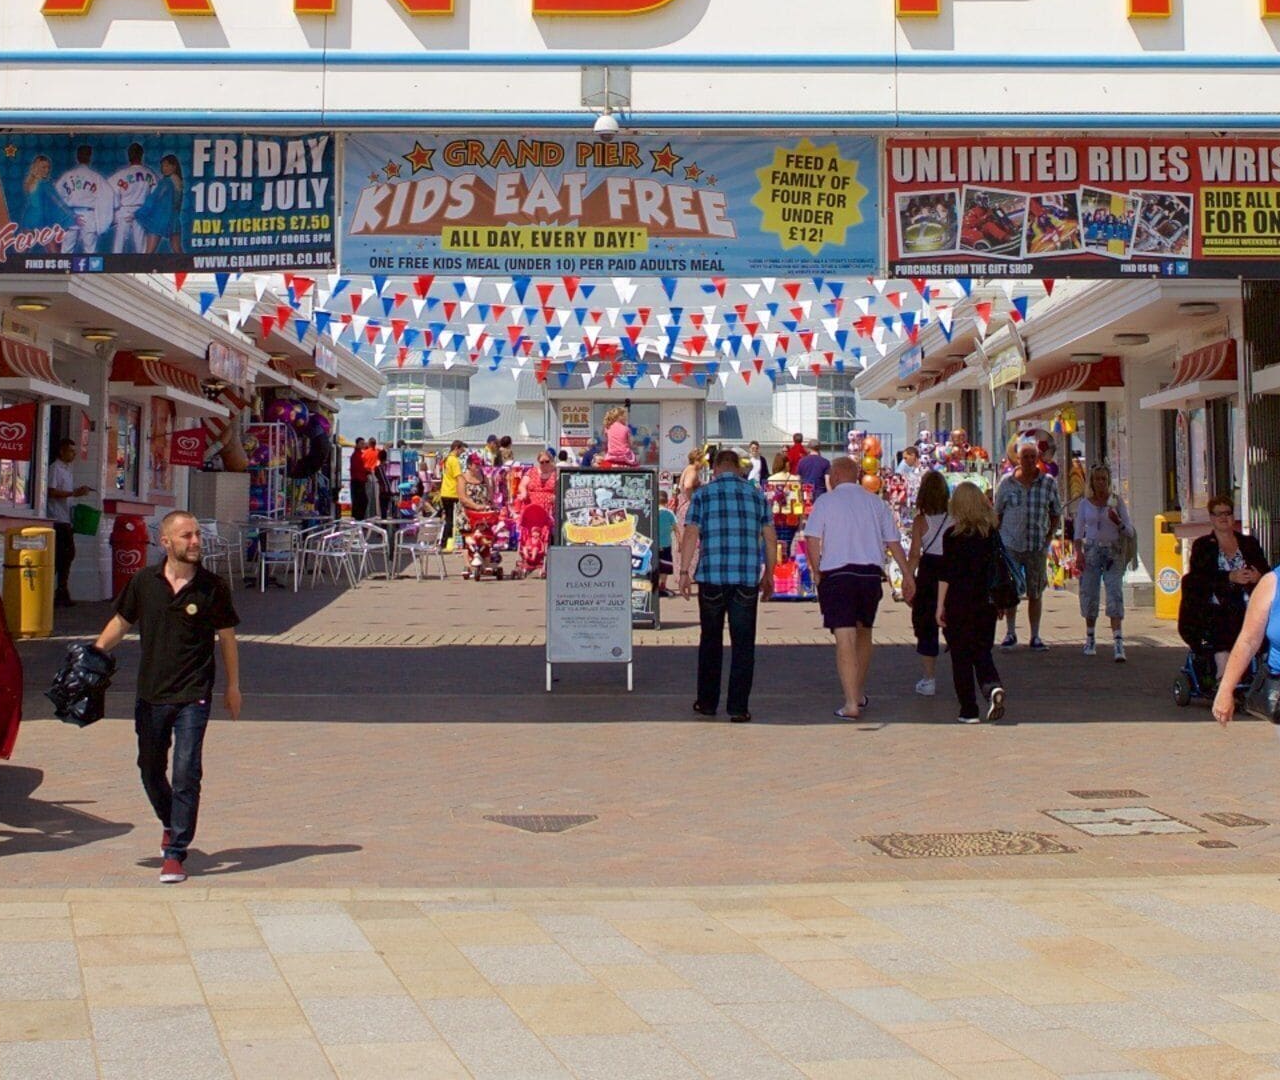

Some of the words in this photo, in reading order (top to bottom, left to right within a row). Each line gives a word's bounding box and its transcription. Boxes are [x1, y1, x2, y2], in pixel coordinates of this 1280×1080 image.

[193, 136, 330, 177] FRIDAY
[444, 139, 565, 168] GRAND
[576, 140, 644, 168] PIER
[786, 154, 824, 171] FEED
[828, 158, 839, 172] A
[892, 146, 1078, 183] UNLIMITED
[1089, 146, 1190, 183] RIDES
[771, 170, 826, 189] FAMILY
[831, 176, 851, 190] OF
[191, 182, 253, 213] 10TH
[261, 178, 329, 211] JULY
[351, 172, 477, 233] KIDS
[494, 168, 588, 217] EAT
[606, 176, 737, 238] FREE
[771, 189, 812, 206] FOUR
[817, 193, 847, 208] FOR
[1205, 191, 1241, 208] RIDE
[1245, 191, 1272, 208] ALL
[192, 219, 224, 234] ADV.
[229, 217, 286, 233] TICKETS
[290, 214, 330, 230] £7.50
[782, 207, 834, 225] UNDER
[1205, 210, 1247, 233] FOR
[232, 235, 248, 246] THE
[250, 235, 273, 246] DOOR
[450, 231, 481, 248] ALL
[487, 231, 524, 250] DAY,
[531, 231, 587, 248] EVERY
[789, 226, 824, 242] £12!
[25, 259, 44, 269] FIND
[45, 259, 56, 269] US
[193, 252, 331, 268] WWW.GRANDPIER.CO.UK
[369, 256, 395, 269] ONE
[398, 256, 429, 269] FREE
[433, 257, 463, 270] KIDS
[467, 257, 501, 270] MEAL
[504, 257, 552, 272] (UNDER
[556, 258, 575, 272] 10)
[580, 258, 604, 270] PER
[608, 258, 637, 270] PAID
[640, 259, 687, 271] ADULTS
[690, 260, 725, 271] MEAL
[1121, 264, 1136, 273] FIND
[895, 264, 943, 275] PURCHASE
[944, 264, 969, 275] FROM
[971, 264, 986, 275] THE
[988, 264, 1007, 274] GIFT
[1009, 264, 1033, 274] SHOP
